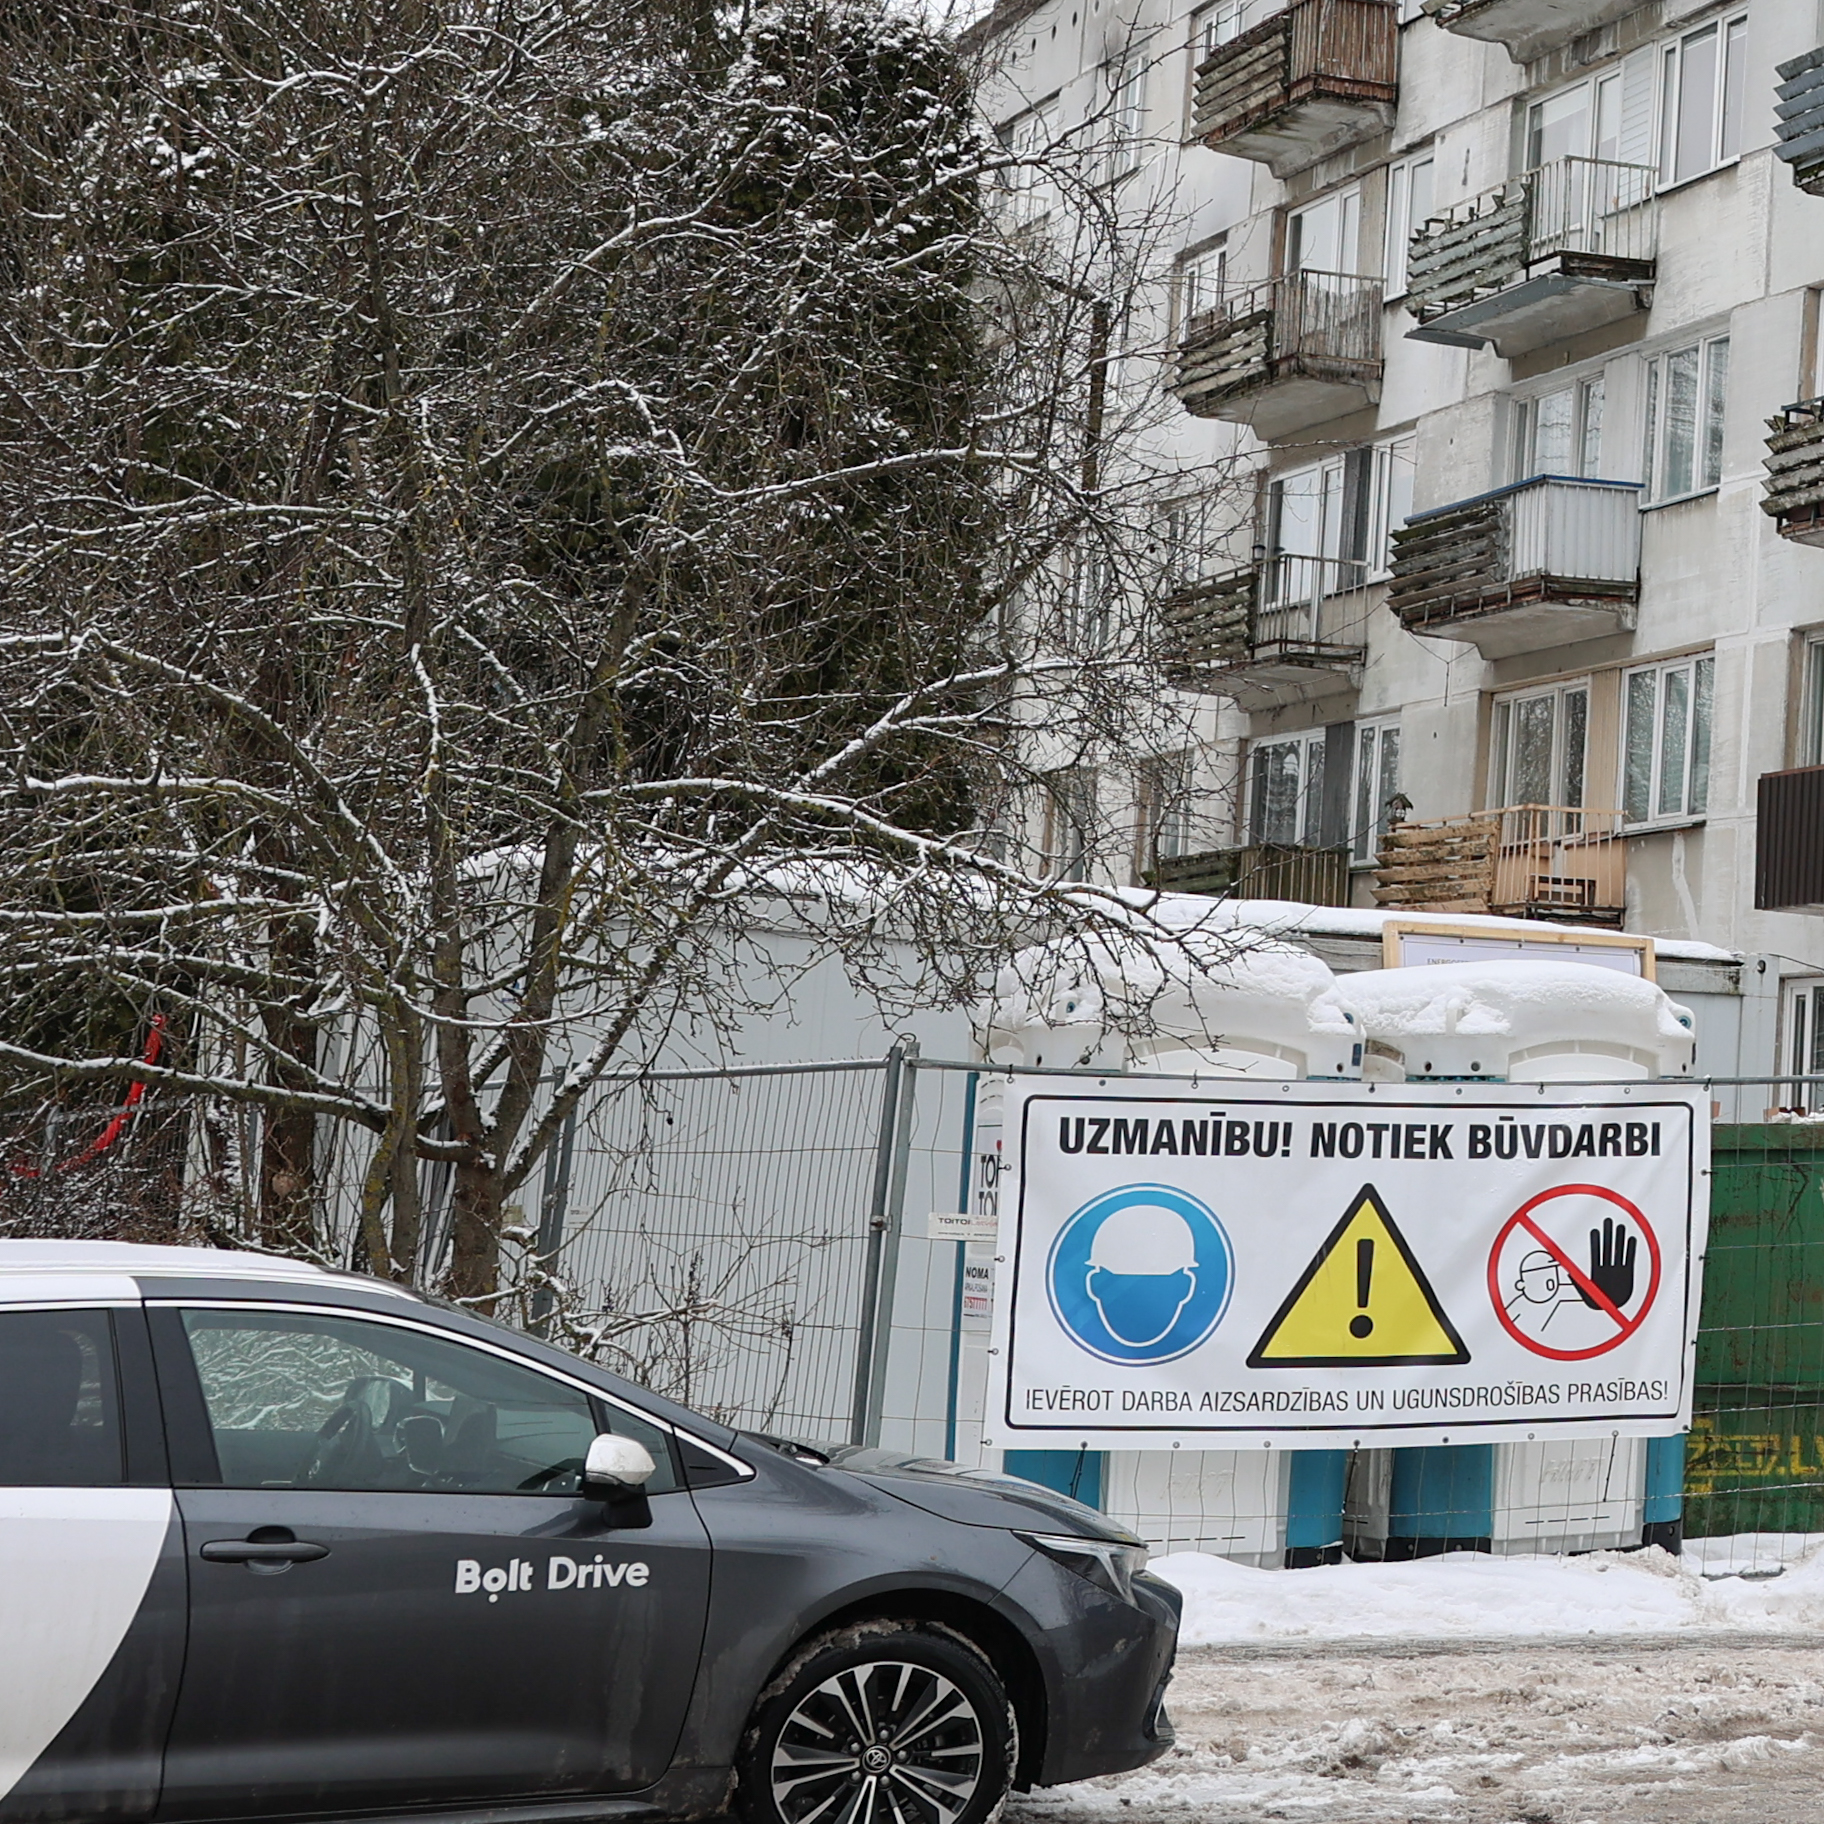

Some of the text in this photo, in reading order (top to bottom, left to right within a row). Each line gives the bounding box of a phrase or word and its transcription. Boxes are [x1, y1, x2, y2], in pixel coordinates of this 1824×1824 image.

[1058, 1111, 1662, 1160] UZMANĪBU! NOTIEK BŪVDARBI
[965, 1266, 989, 1280] NOMA
[1025, 1377, 1669, 1412] IEVĒROT DARBA AIZSARDZĪBAS UN UGUNSDROŠĪBAS PRASĪBAS!
[455, 1554, 650, 1603] Bolt Drive
